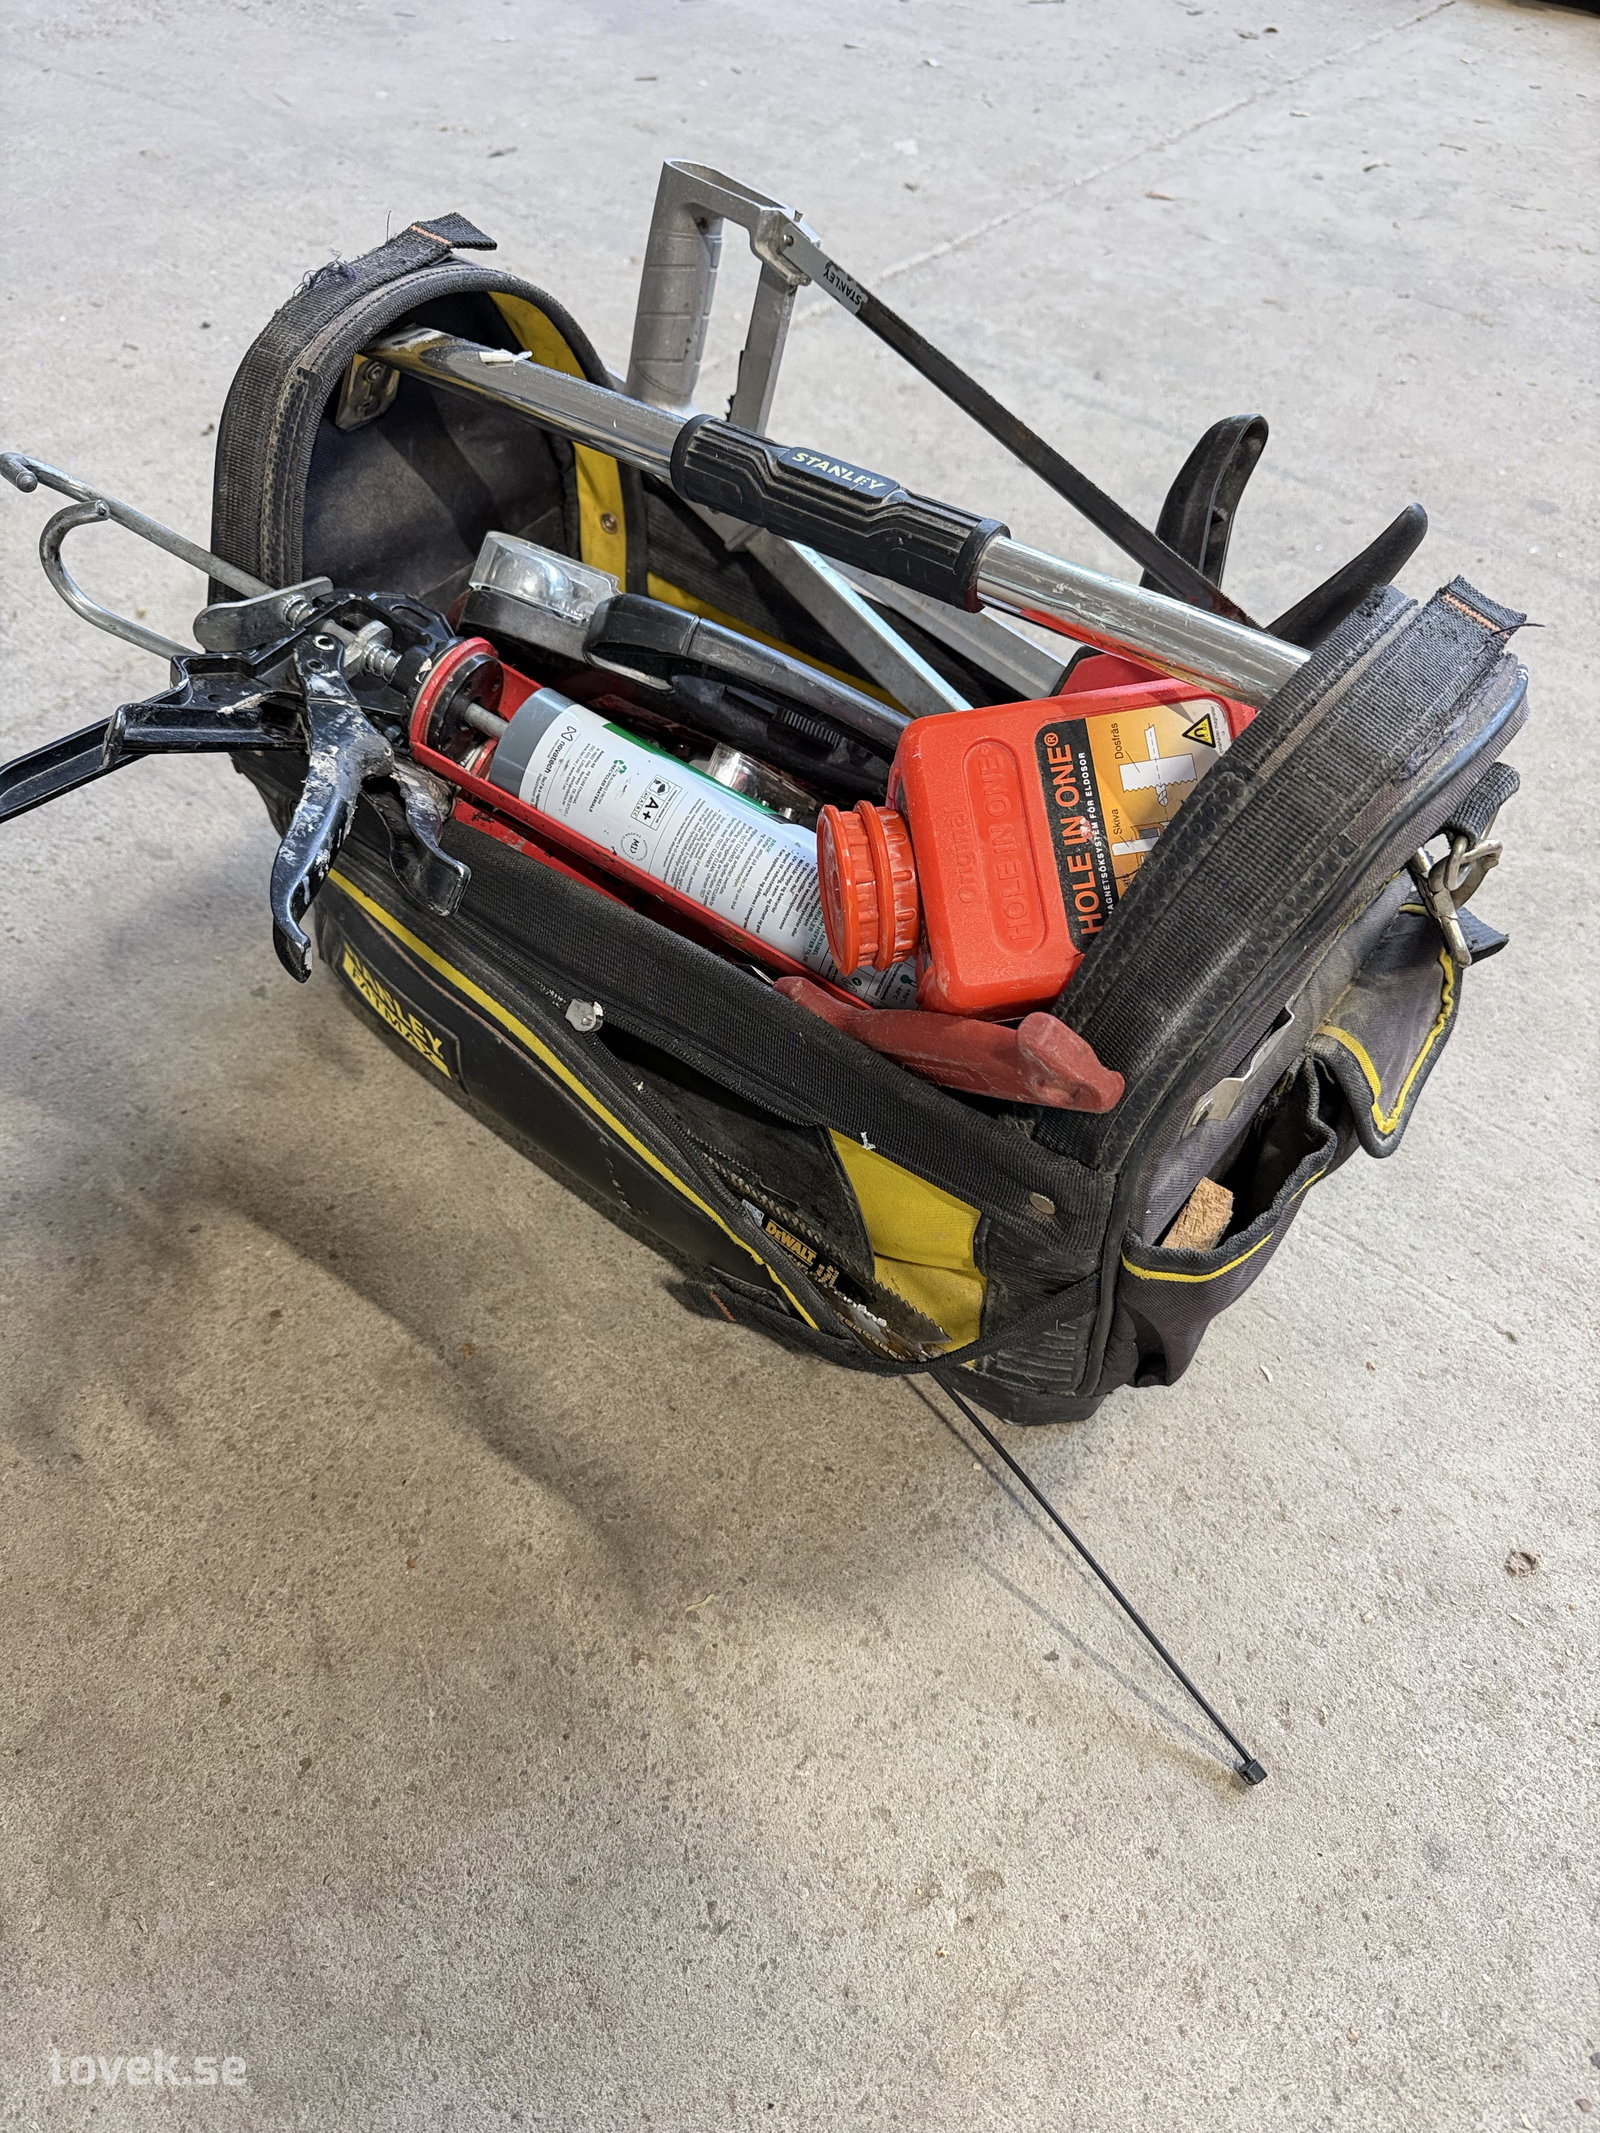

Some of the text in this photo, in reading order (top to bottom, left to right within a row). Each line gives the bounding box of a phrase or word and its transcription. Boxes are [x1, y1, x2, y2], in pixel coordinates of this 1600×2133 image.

[823, 268, 861, 305] STANLEY
[792, 452, 886, 490] STANLEY
[544, 740, 565, 773] novatech
[1108, 722, 1124, 760] Dosfräs
[588, 764, 616, 812] RECYCLED MATERIALS
[1077, 751, 1093, 796] ELDOSOR
[642, 796, 658, 819] A+
[1084, 798, 1097, 819] FÖR
[1108, 808, 1123, 835] Skiva
[988, 823, 1017, 854] IN
[1059, 815, 1086, 845] IN
[727, 843, 741, 862] CLEANER
[944, 806, 976, 905] Original
[995, 862, 1032, 943] HOLE
[1066, 852, 1104, 934] HOLE
[808, 925, 821, 948] HEFTER
